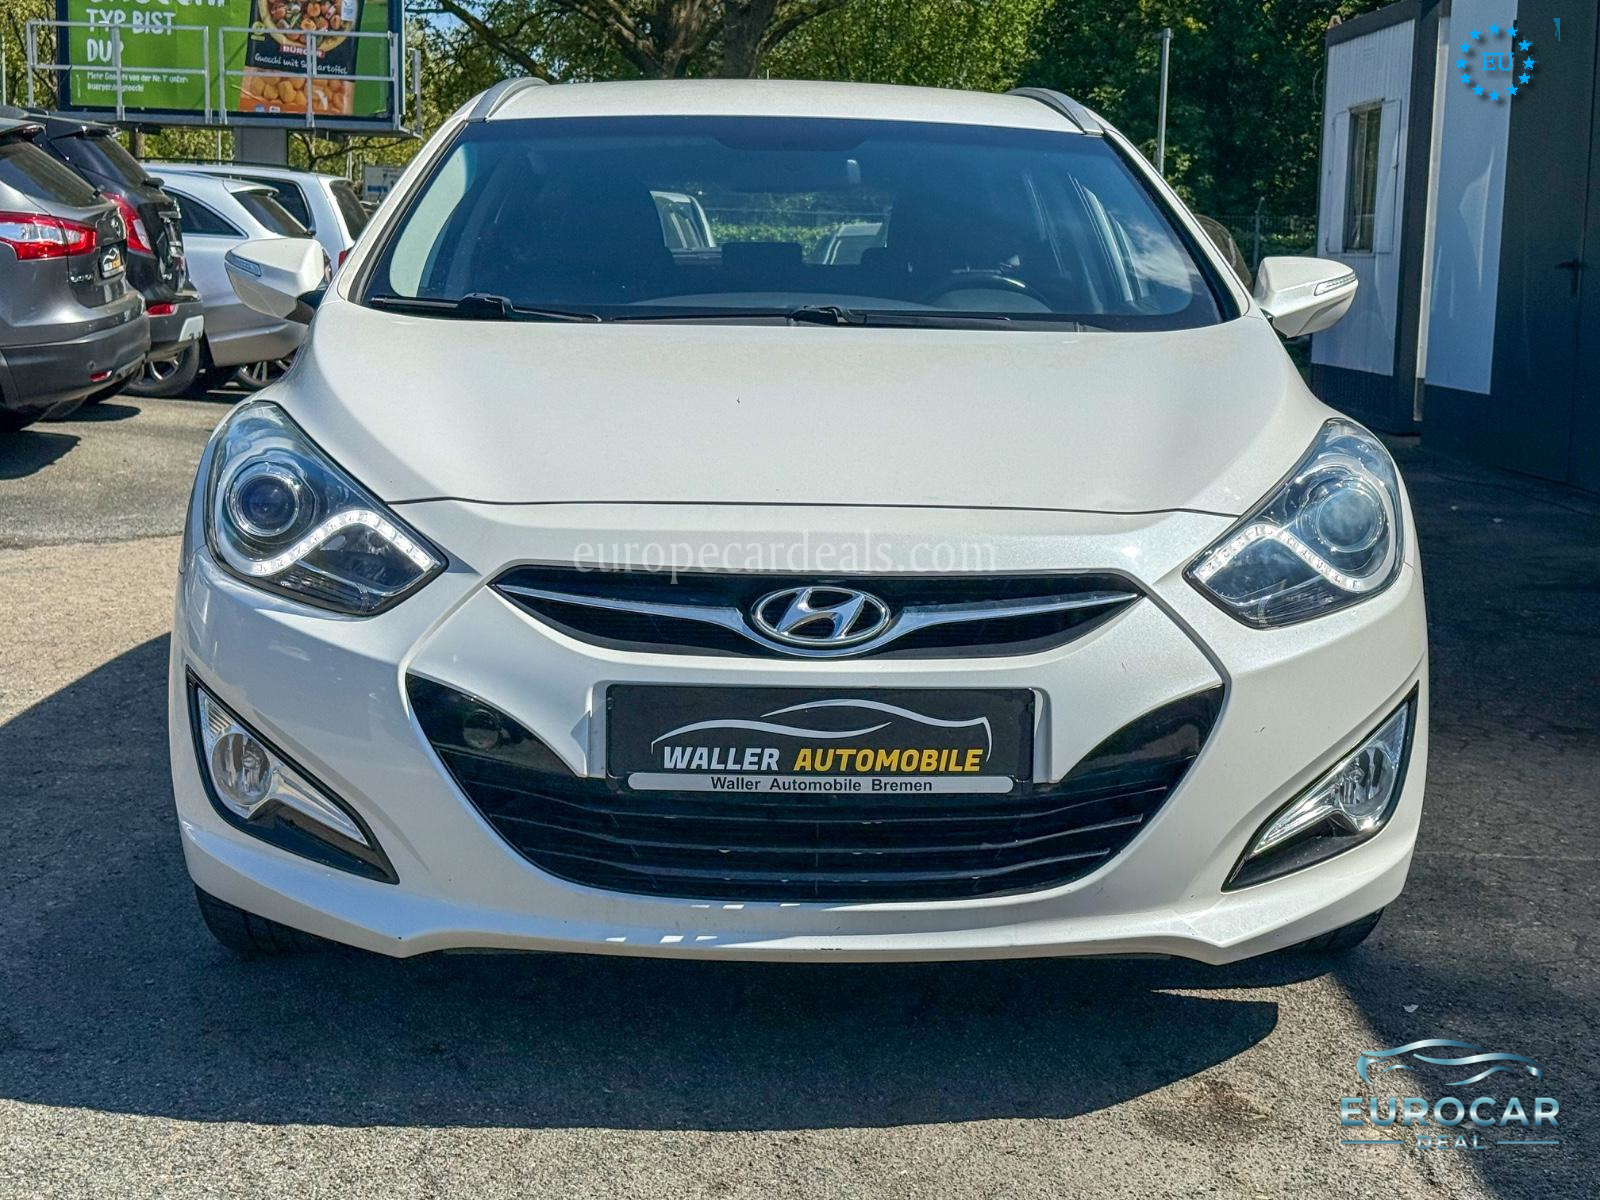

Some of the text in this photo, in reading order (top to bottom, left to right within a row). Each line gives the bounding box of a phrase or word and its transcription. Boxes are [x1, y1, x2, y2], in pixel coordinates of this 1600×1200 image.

[85, 8, 177, 36] TYP BIST
[663, 746, 984, 773] WALLER AUTOMOBILE
[710, 776, 933, 792] Waller Automobile Bremen
